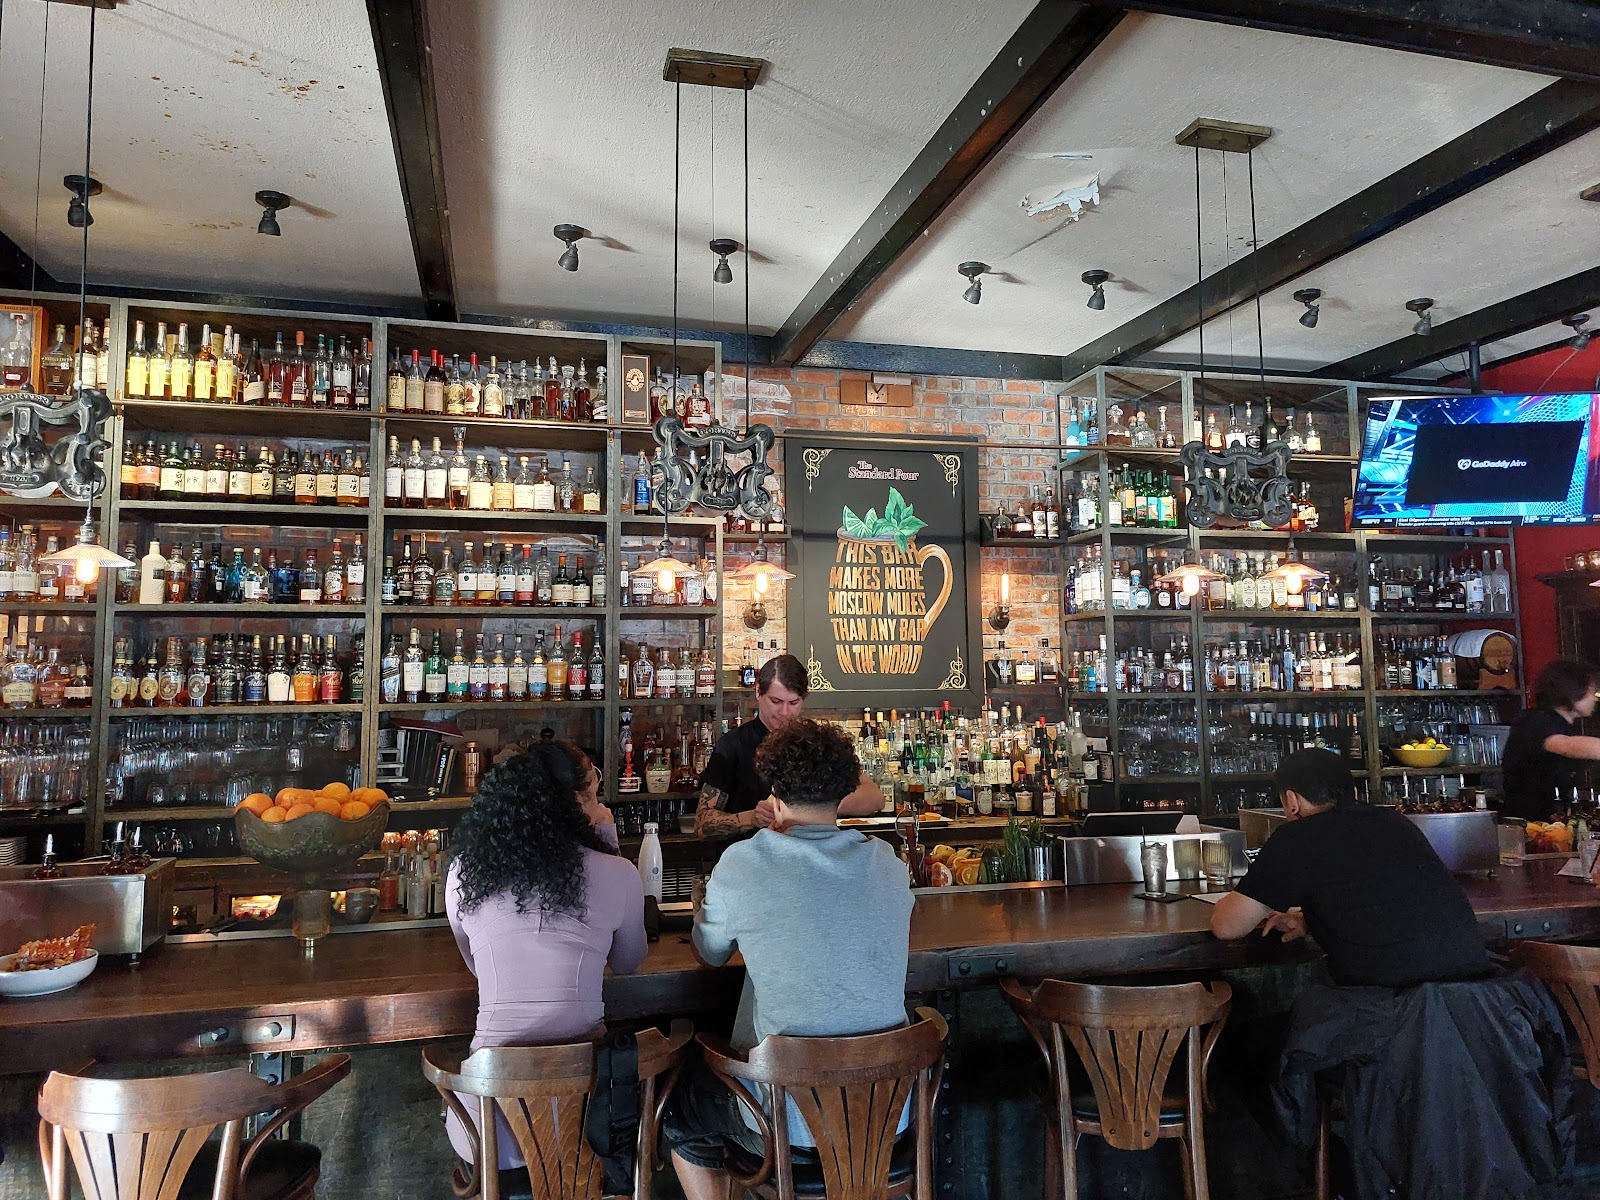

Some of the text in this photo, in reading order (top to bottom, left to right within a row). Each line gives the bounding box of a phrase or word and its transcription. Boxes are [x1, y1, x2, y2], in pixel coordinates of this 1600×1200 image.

[847, 466, 919, 481] Standard Pour
[1471, 460, 1527, 469] GoDaddy Airo
[836, 542, 921, 566] THIS BAR
[829, 566, 925, 591] MAKES MORE
[828, 591, 926, 617] MOSCOW MULES
[830, 617, 925, 642] THAN ANY BAR
[836, 644, 923, 674] IN THE WORLD
